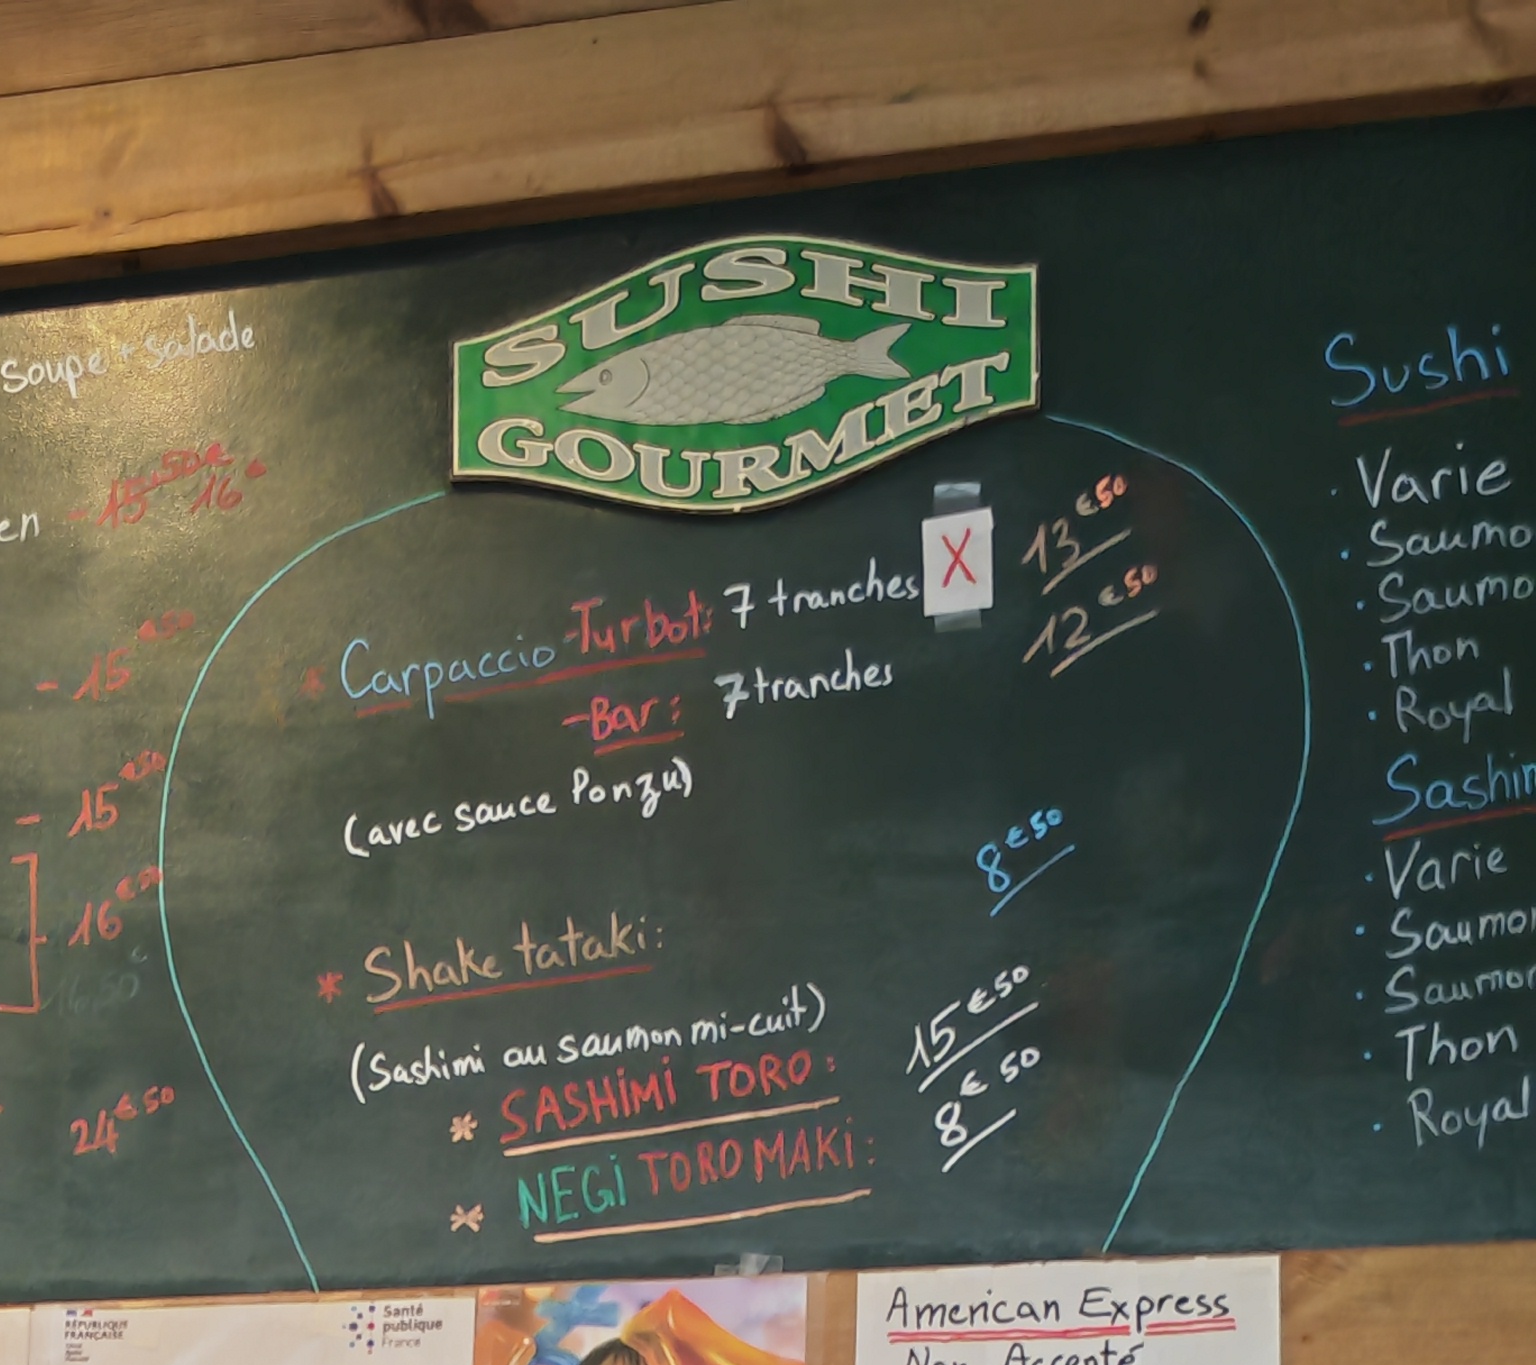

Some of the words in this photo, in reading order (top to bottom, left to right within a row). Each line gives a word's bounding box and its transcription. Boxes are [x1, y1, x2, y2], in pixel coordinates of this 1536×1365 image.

[482, 246, 1007, 388] SUSHI
[1325, 324, 1509, 406] Sushi
[477, 352, 1010, 500] GOURMET
[941, 528, 976, 588] X
[339, 635, 556, 719] Carpaccio
[724, 583, 756, 629] 7
[769, 566, 919, 616] tranches
[1381, 629, 1479, 679] Thon
[1395, 666, 1513, 744] Royal
[455, 792, 556, 832] sauce
[1384, 840, 1508, 900] Varie
[364, 937, 503, 1003] Shake
[504, 1042, 547, 1068] au
[1395, 1021, 1518, 1082] Thon
[1408, 1075, 1529, 1150] Royal
[383, 1319, 442, 1334] publique
[885, 1286, 1060, 1329] American
[1078, 1287, 1230, 1333] Express
